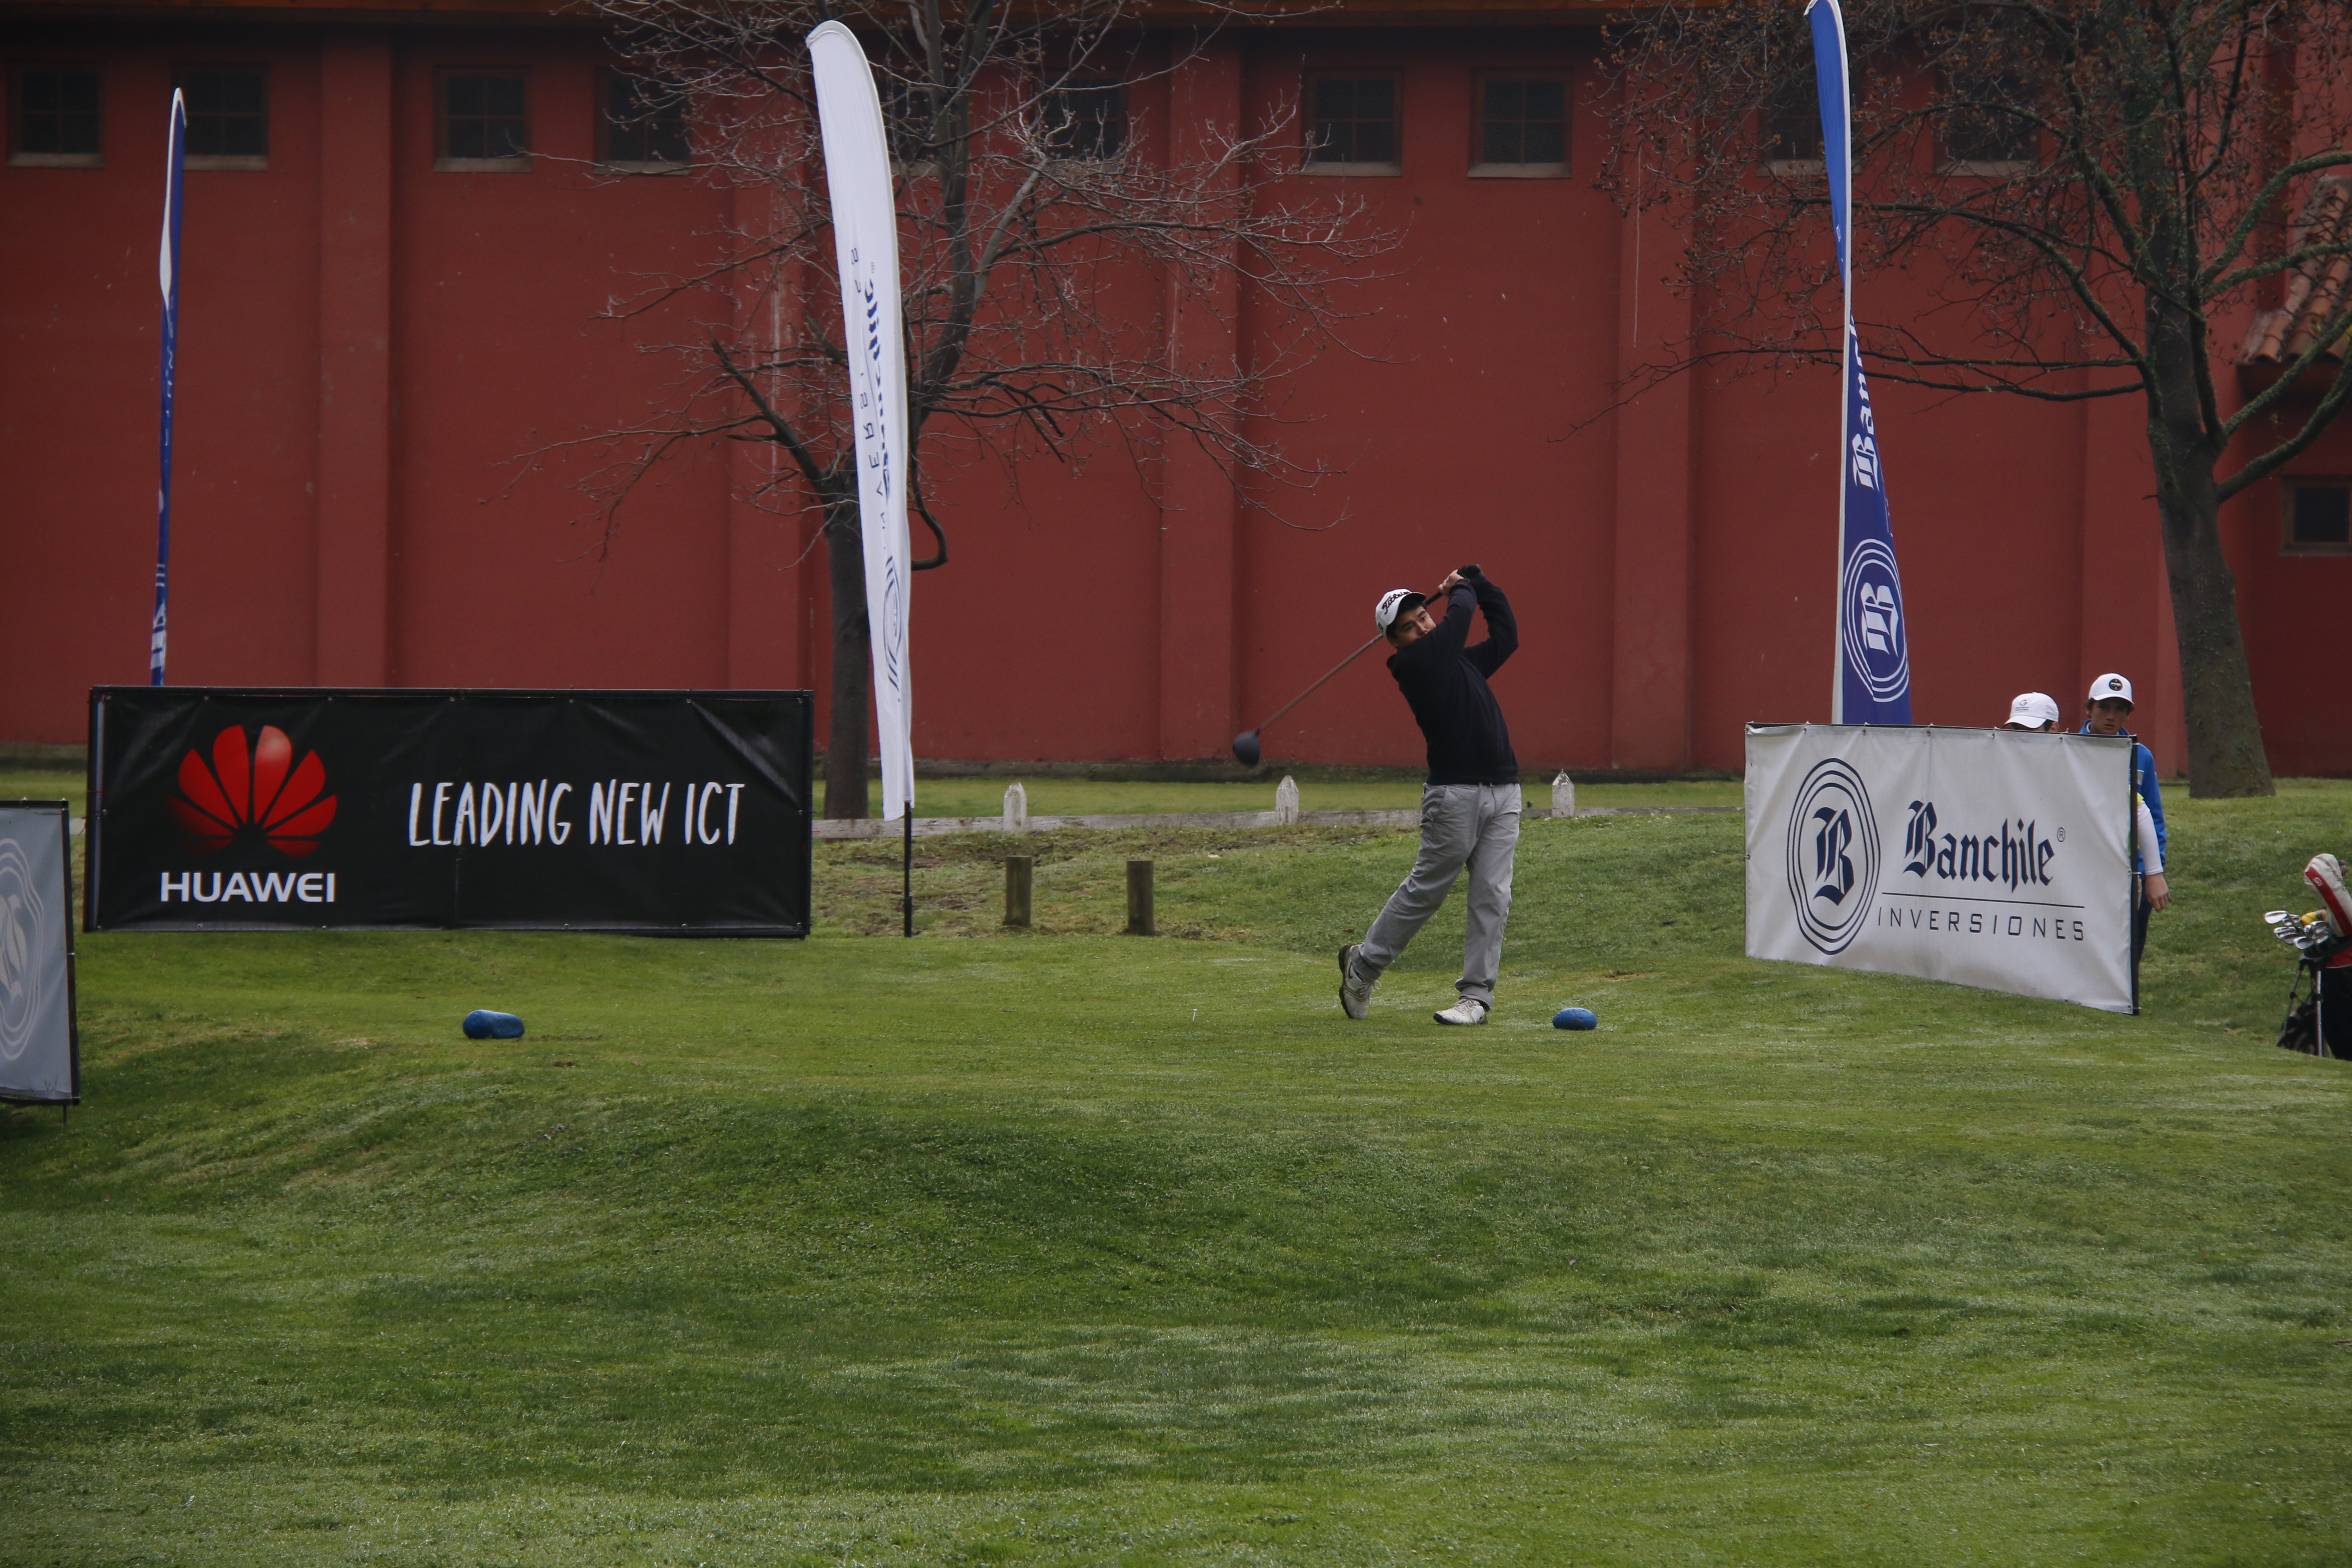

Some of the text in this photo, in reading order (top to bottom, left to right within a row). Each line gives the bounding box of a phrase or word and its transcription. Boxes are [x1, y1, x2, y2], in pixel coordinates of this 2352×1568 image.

[408, 779, 745, 847] LEADING NEW ICT
[1903, 800, 2055, 893] Banchile
[161, 872, 335, 902] HUAWEI
[1812, 807, 1854, 905] B
[1878, 906, 2084, 940] INVERSIONES
